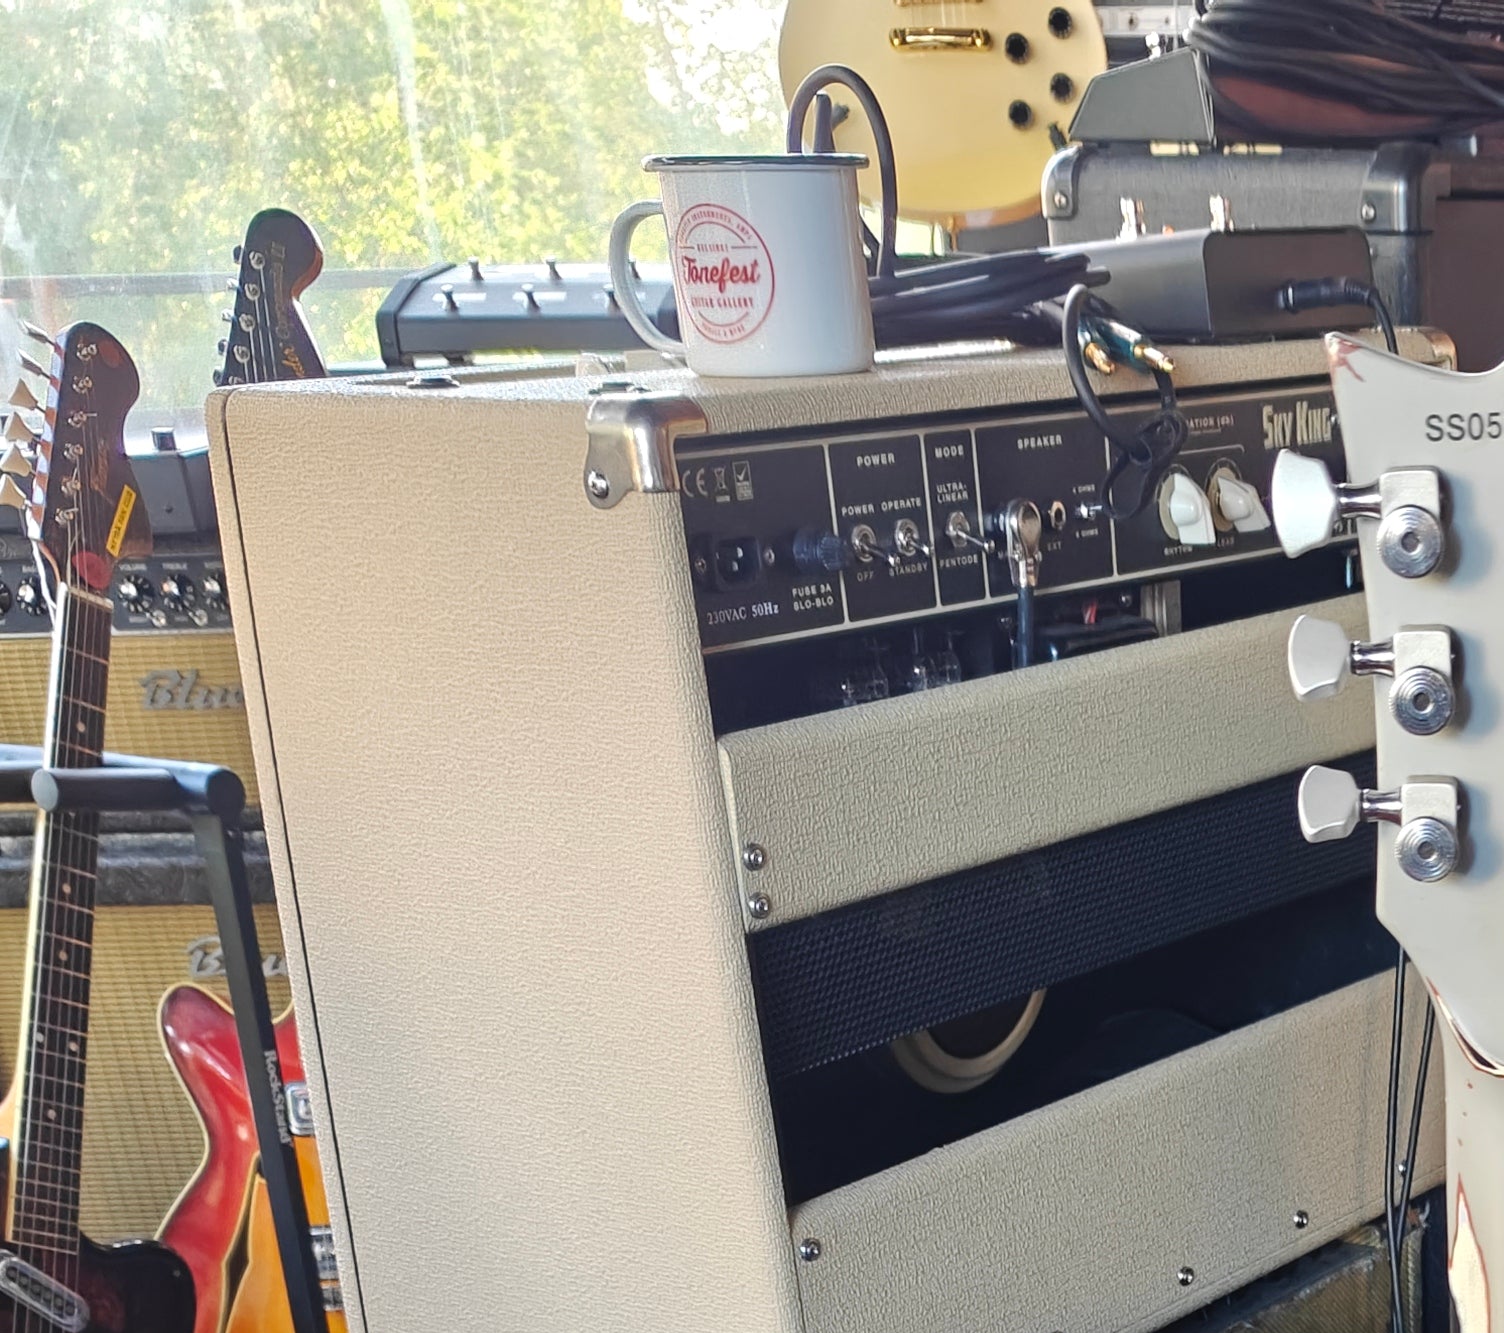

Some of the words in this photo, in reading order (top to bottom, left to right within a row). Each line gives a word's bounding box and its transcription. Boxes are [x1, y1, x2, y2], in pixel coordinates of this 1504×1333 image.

[682, 255, 761, 294] Tonefest
[1018, 434, 1063, 450] SPEAKER
[935, 445, 964, 458] MODE
[857, 453, 896, 467] POWER
[936, 482, 968, 494] ULTRA-
[937, 491, 969, 504] LINEAR
[841, 503, 875, 517] POWER
[881, 497, 922, 512] OPERATE
[939, 555, 979, 569] PENTODE
[857, 571, 874, 582] OFF
[889, 562, 929, 578] STANDBY
[792, 586, 817, 598] FUSE
[707, 607, 748, 625] 230VAC
[751, 602, 779, 618] 50Hz
